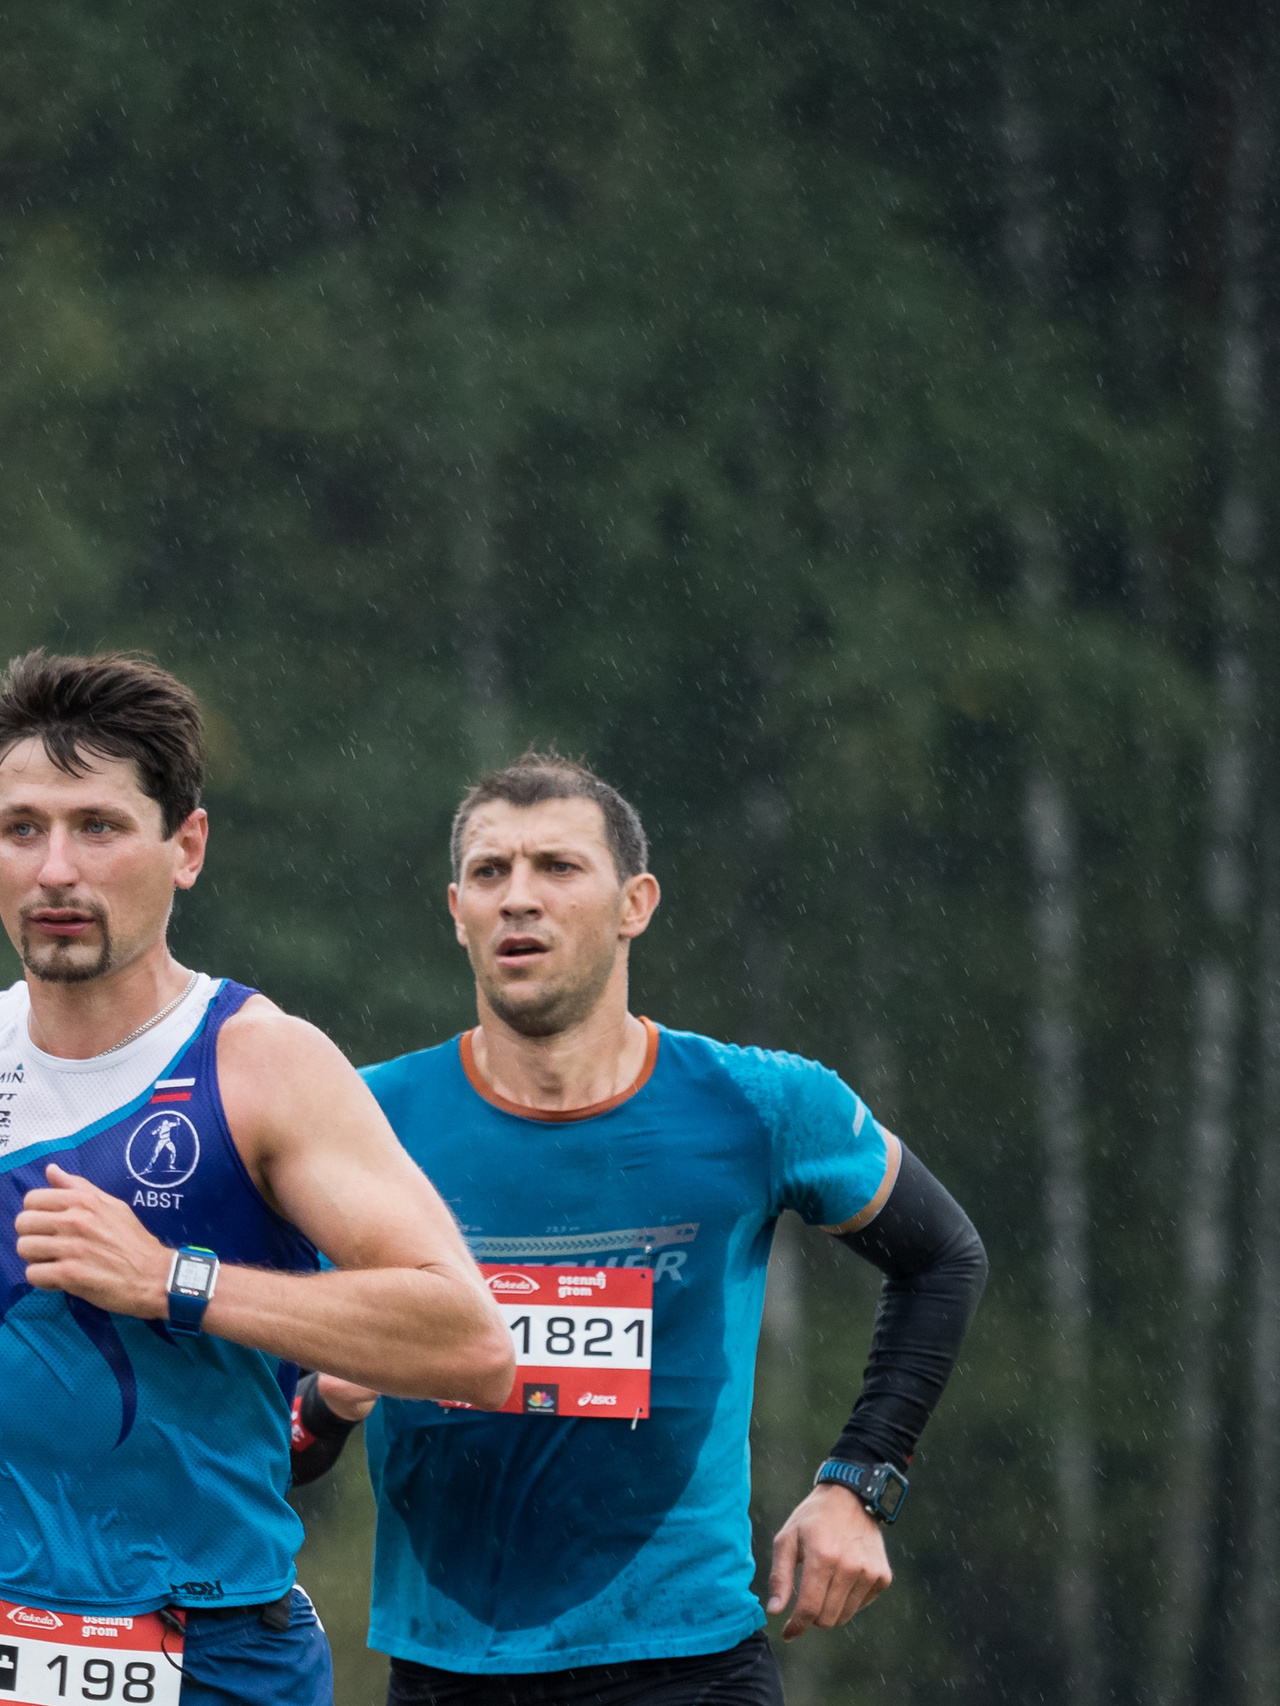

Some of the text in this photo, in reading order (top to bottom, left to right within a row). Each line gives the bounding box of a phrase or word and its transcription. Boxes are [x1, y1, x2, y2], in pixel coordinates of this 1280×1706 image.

[133, 1190, 184, 1210] ABST
[493, 1280, 530, 1290] Takeda
[558, 1286, 593, 1299] grom
[510, 1316, 645, 1358] 1821
[17, 1611, 55, 1626] Takeda
[81, 1625, 118, 1638] grom
[47, 1654, 156, 1704] 198
